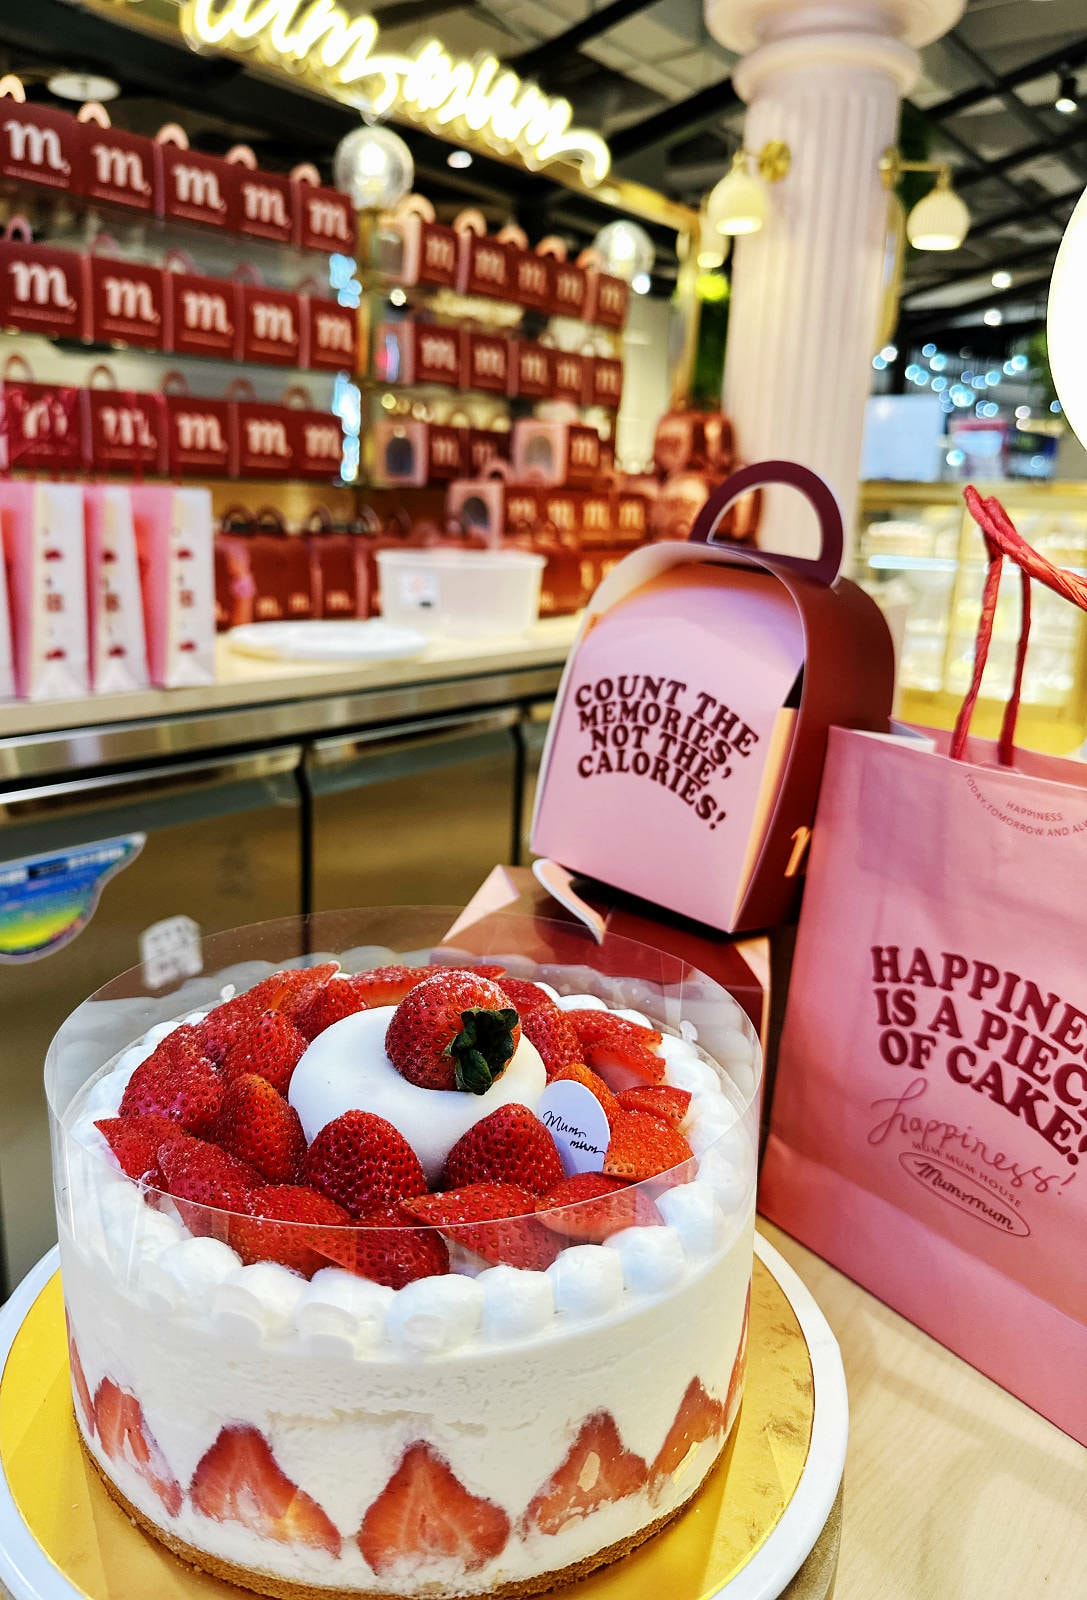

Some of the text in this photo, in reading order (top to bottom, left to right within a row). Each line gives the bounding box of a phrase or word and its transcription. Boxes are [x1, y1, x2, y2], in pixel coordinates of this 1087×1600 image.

[2, 119, 72, 174] m
[92, 144, 151, 193] m
[172, 164, 227, 211] m
[242, 183, 291, 227] m
[307, 199, 353, 242] m
[9, 261, 76, 308] m
[103, 277, 161, 323] m
[182, 291, 234, 334] m
[251, 303, 298, 344] m
[176, 414, 227, 452] m
[246, 420, 292, 457] m
[575, 675, 759, 757] COUNT THE
[578, 700, 732, 779] MEMORIES,
[591, 724, 716, 786] NOT THE
[577, 749, 727, 830] CALORIES!
[1006, 801, 1064, 821] HAPPINESS
[1047, 828, 1070, 837] AND
[871, 945, 1087, 1063] HAPPINE
[873, 987, 1087, 1122] IS A PIEC
[879, 1028, 937, 1070] OF
[543, 1110, 587, 1138] Mum
[867, 1077, 1077, 1197] happiness!
[569, 1139, 606, 1156] mum
